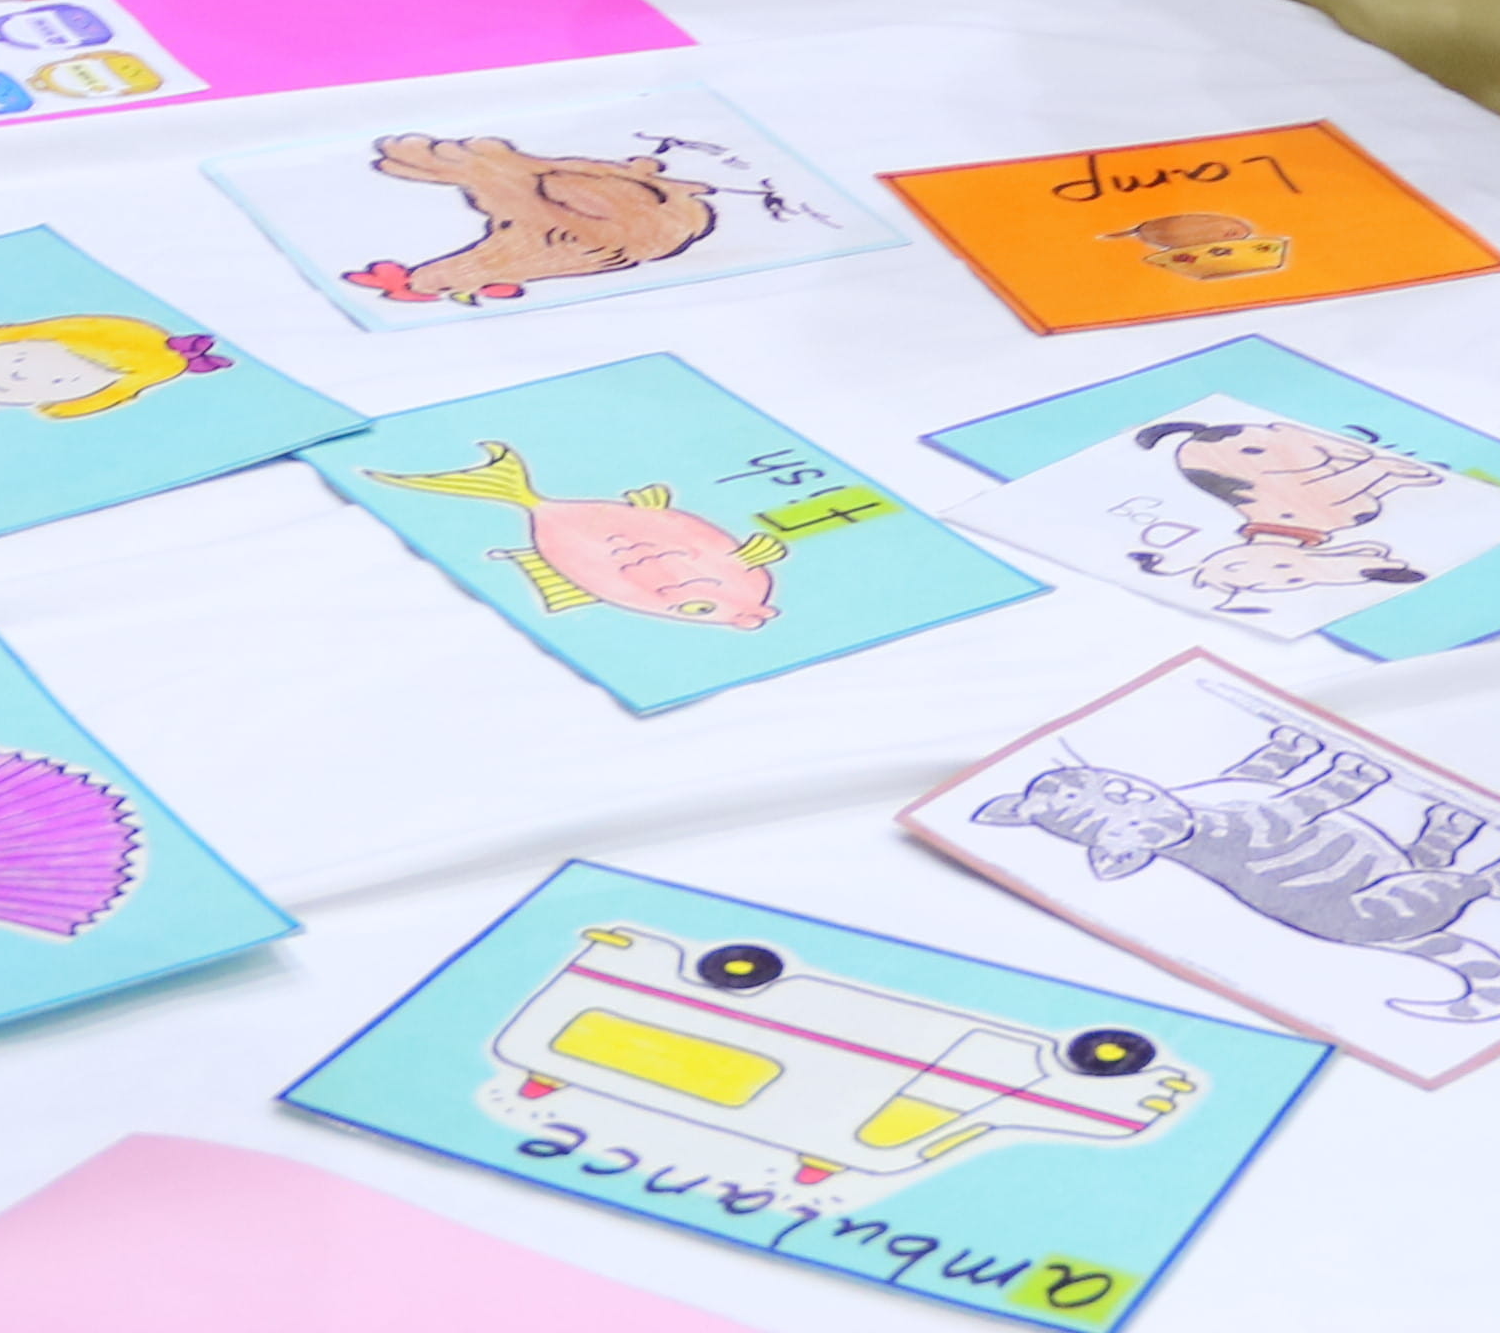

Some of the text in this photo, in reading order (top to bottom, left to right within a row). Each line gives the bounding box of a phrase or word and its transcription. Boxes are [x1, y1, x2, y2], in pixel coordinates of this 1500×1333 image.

[1051, 153, 1303, 202] Lamp
[714, 447, 884, 532] fish
[1105, 494, 1201, 549] Dog
[515, 1121, 1116, 1310] ambulance
